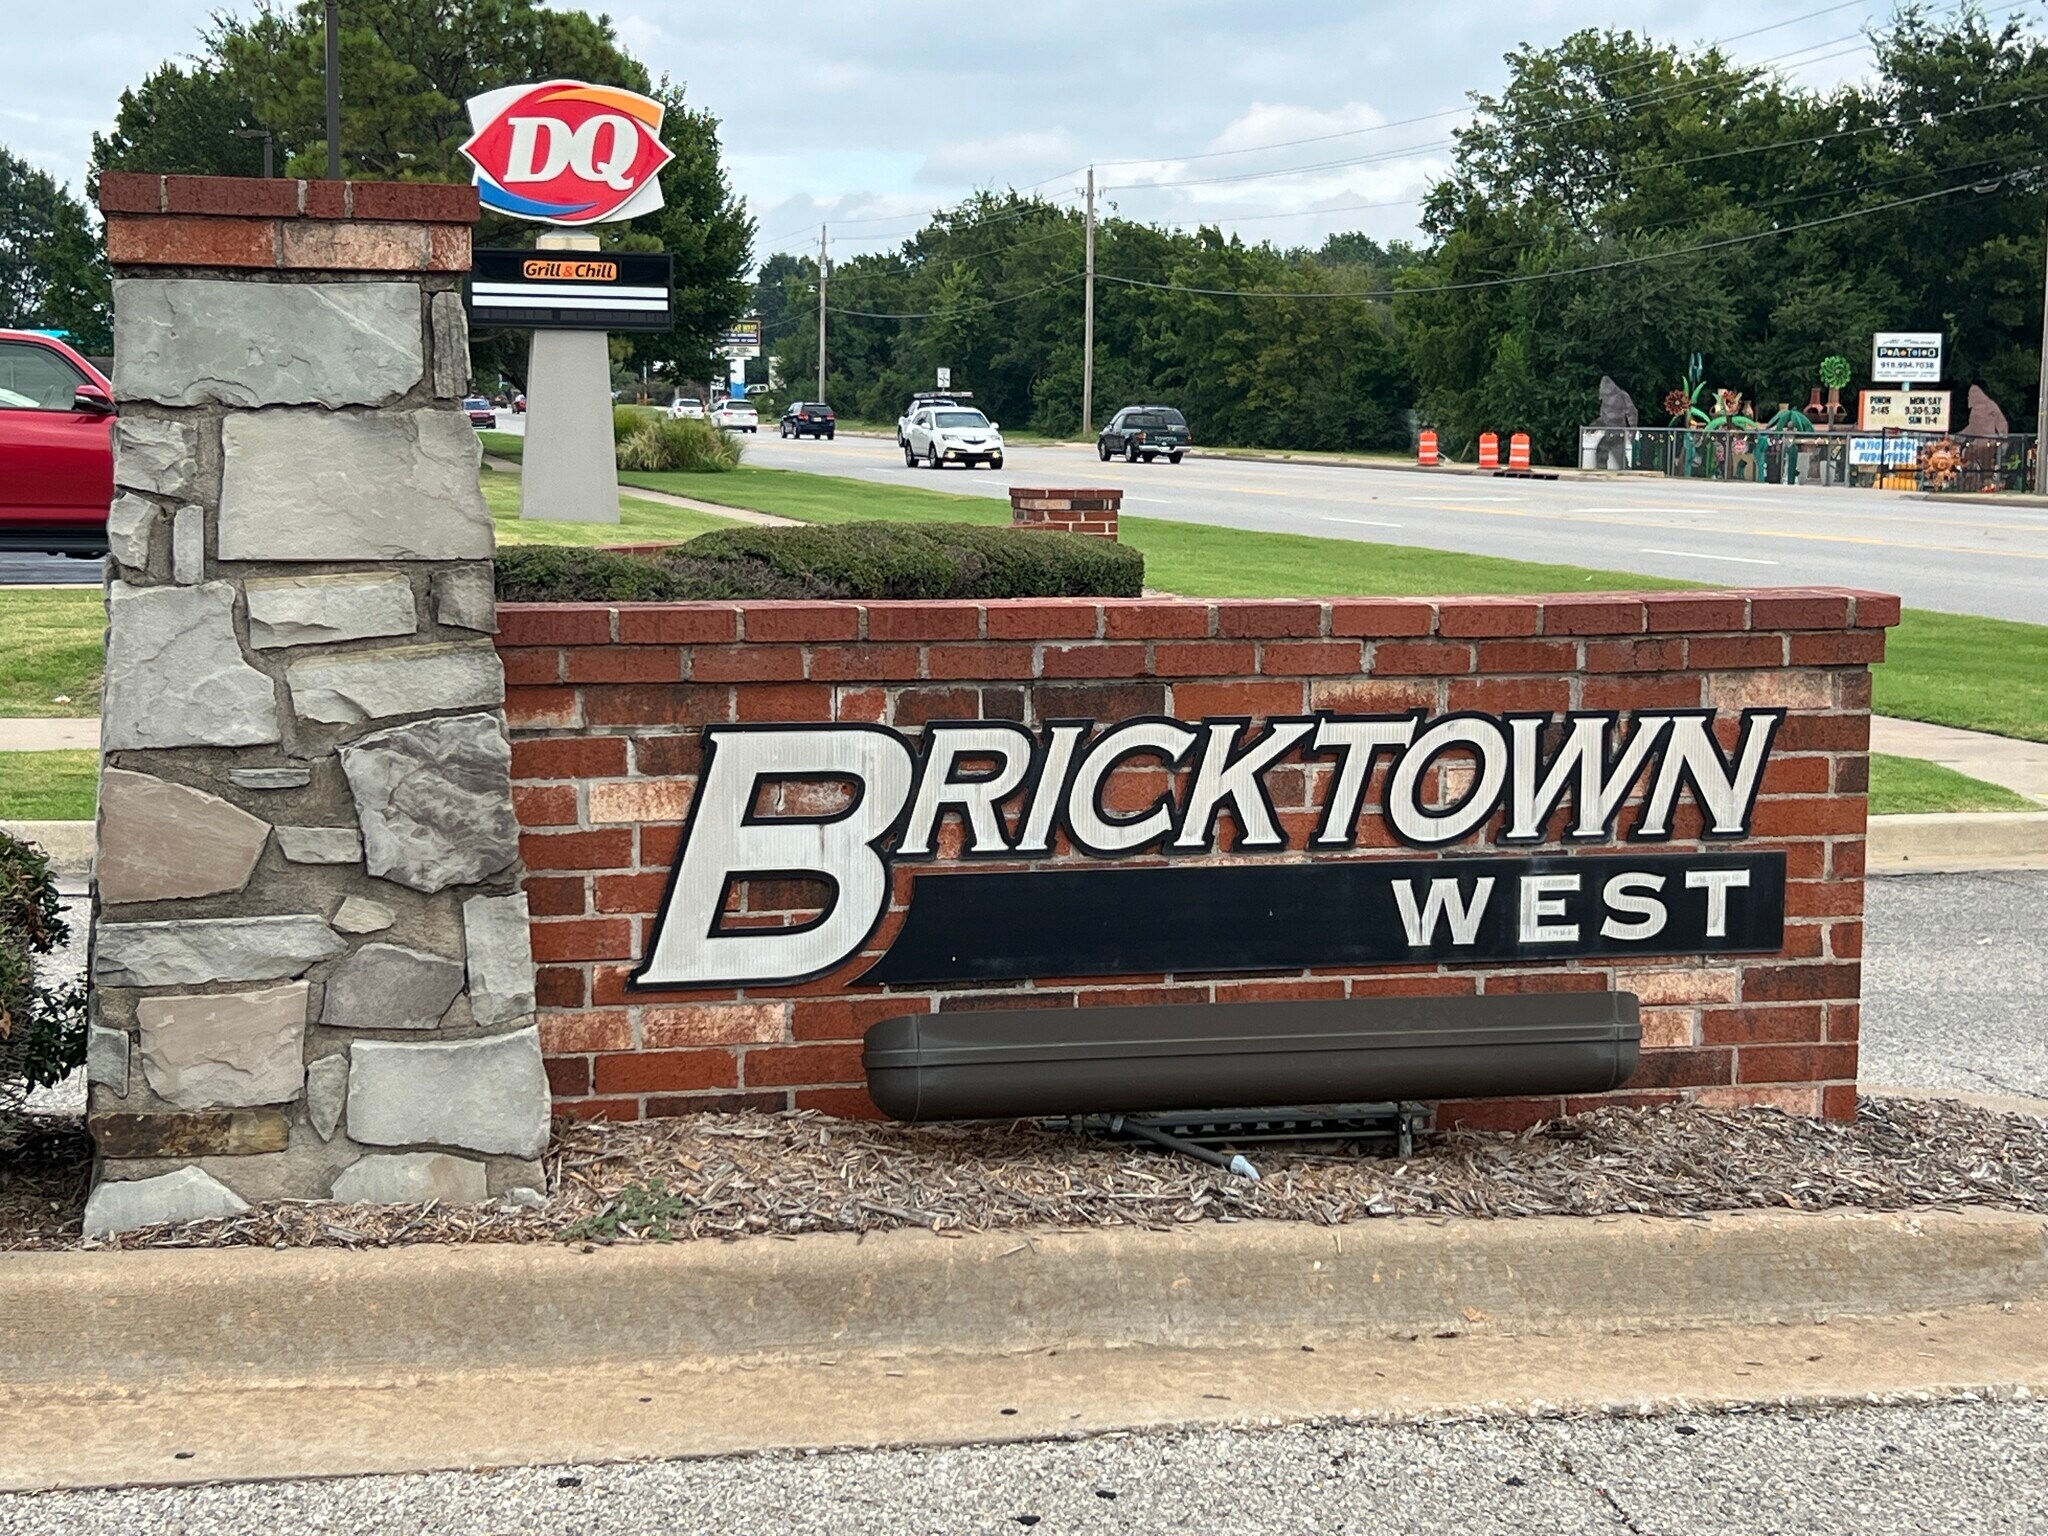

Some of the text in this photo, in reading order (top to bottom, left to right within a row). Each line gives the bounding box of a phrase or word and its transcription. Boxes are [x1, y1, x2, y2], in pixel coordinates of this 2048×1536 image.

[503, 113, 640, 192] DQ
[525, 262, 561, 277] Grill
[575, 263, 613, 279] Chill
[636, 713, 1780, 985] BRICKTOWN
[1391, 868, 1750, 947] WEST
